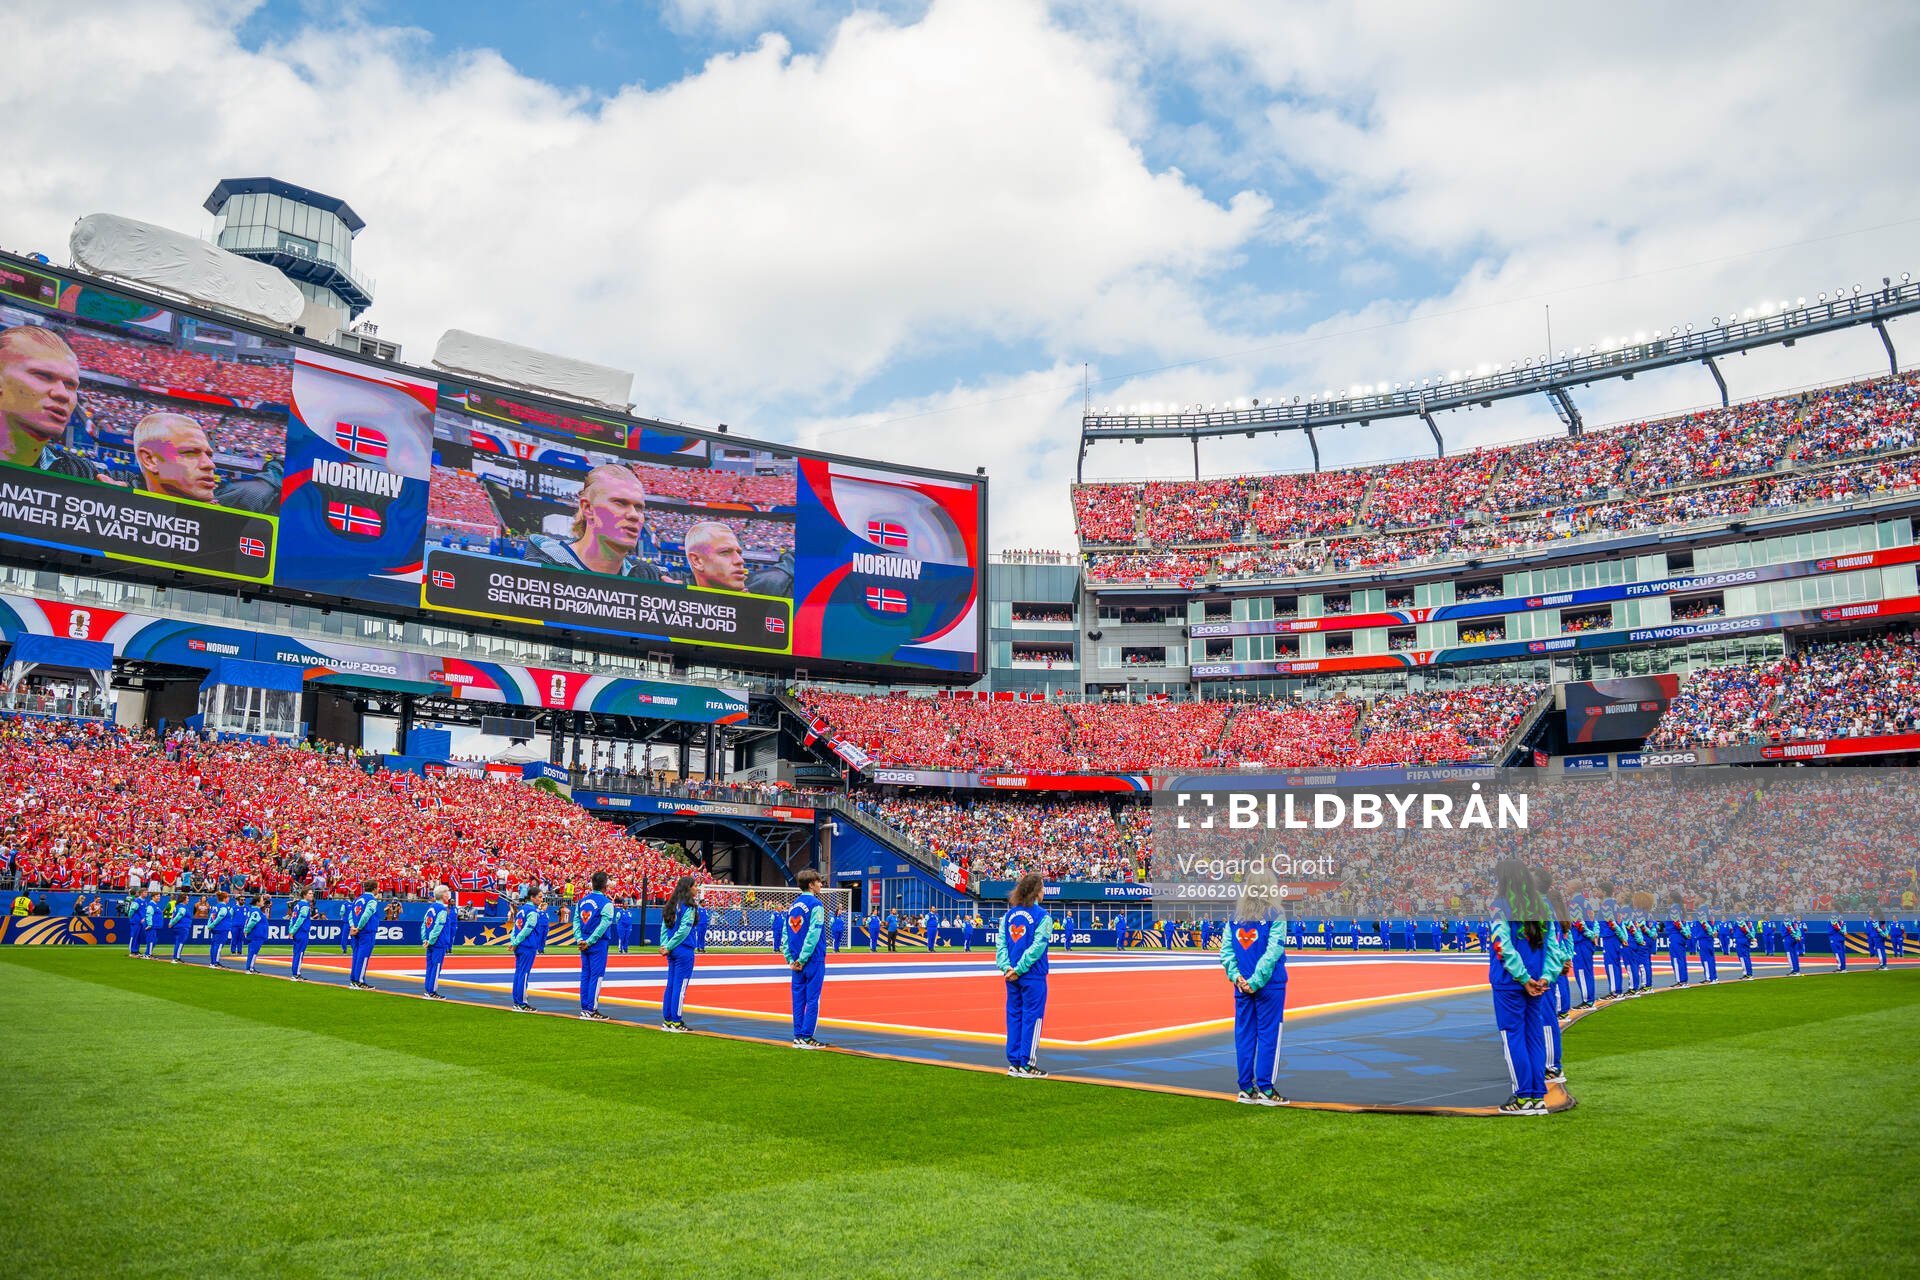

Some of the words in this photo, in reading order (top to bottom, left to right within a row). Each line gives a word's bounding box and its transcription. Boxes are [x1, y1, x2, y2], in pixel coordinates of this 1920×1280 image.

[312, 458, 403, 498] NORWAY
[0, 483, 62, 508] NATT
[65, 496, 116, 520] SOM
[120, 507, 200, 536] SENKER
[61, 512, 91, 533] PÅ
[95, 519, 138, 542] VÅR
[141, 530, 200, 553] JORD
[852, 552, 922, 580] NORWAY
[1836, 554, 1874, 568] NORWAY
[1626, 585, 1650, 596] FIFA
[1651, 580, 1690, 592] WORLD
[1692, 577, 1714, 587] CUP
[1715, 571, 1757, 584] 2026
[489, 572, 514, 589] OG
[517, 578, 550, 594] DEN
[552, 581, 638, 606] SAGANATT
[641, 595, 677, 612] SOM
[679, 599, 737, 620] SENKER
[1542, 594, 1573, 606] NORWAY
[487, 588, 552, 610] SENKER
[553, 597, 637, 622] DRØMMER
[639, 606, 660, 624] PÅ
[661, 611, 693, 629] VÅR
[694, 616, 737, 633] JORD
[1841, 604, 1879, 617] NORWAY
[1196, 625, 1229, 634] 2026
[1290, 621, 1318, 630] NORWAY
[1629, 631, 1653, 641] FIFA
[1654, 626, 1694, 638] WORLD
[1696, 622, 1719, 633] CUP
[1720, 618, 1761, 631] 2026
[206, 642, 240, 655] NORWAY
[1545, 638, 1576, 651] NORWAY
[276, 652, 299, 663] FIFA
[301, 655, 339, 668] WORLD
[340, 660, 360, 670] CUP
[361, 663, 397, 675] 2026
[1197, 666, 1230, 674] 2026
[1291, 662, 1319, 671] NORWAY
[444, 672, 474, 684] NORWAY
[652, 695, 678, 706] NORWAY
[706, 701, 724, 710] FIFA
[1605, 703, 1638, 715] NORWAY
[1783, 743, 1826, 757] NORWAY
[1650, 752, 1697, 765] 2026
[543, 766, 568, 782] BOSTON
[879, 772, 915, 783] 2026
[1406, 770, 1431, 780] FIFA
[1432, 767, 1473, 779] WORLD
[996, 776, 1027, 787] NORWAY
[1304, 775, 1337, 786] NORWAY
[658, 801, 673, 810] FIFA
[674, 802, 699, 812] WORLD
[700, 805, 714, 813] CUP
[715, 806, 738, 814] 2026
[1104, 887, 1125, 896] FIFA
[1127, 886, 1160, 896] WORLD
[309, 925, 341, 940] CUP
[375, 926, 403, 940] 26
[704, 930, 737, 941] ORLD
[739, 930, 763, 941] CUP
[1302, 935, 1326, 945] WORL
[1334, 936, 1353, 945] CUP
[1357, 935, 1382, 945] 202
